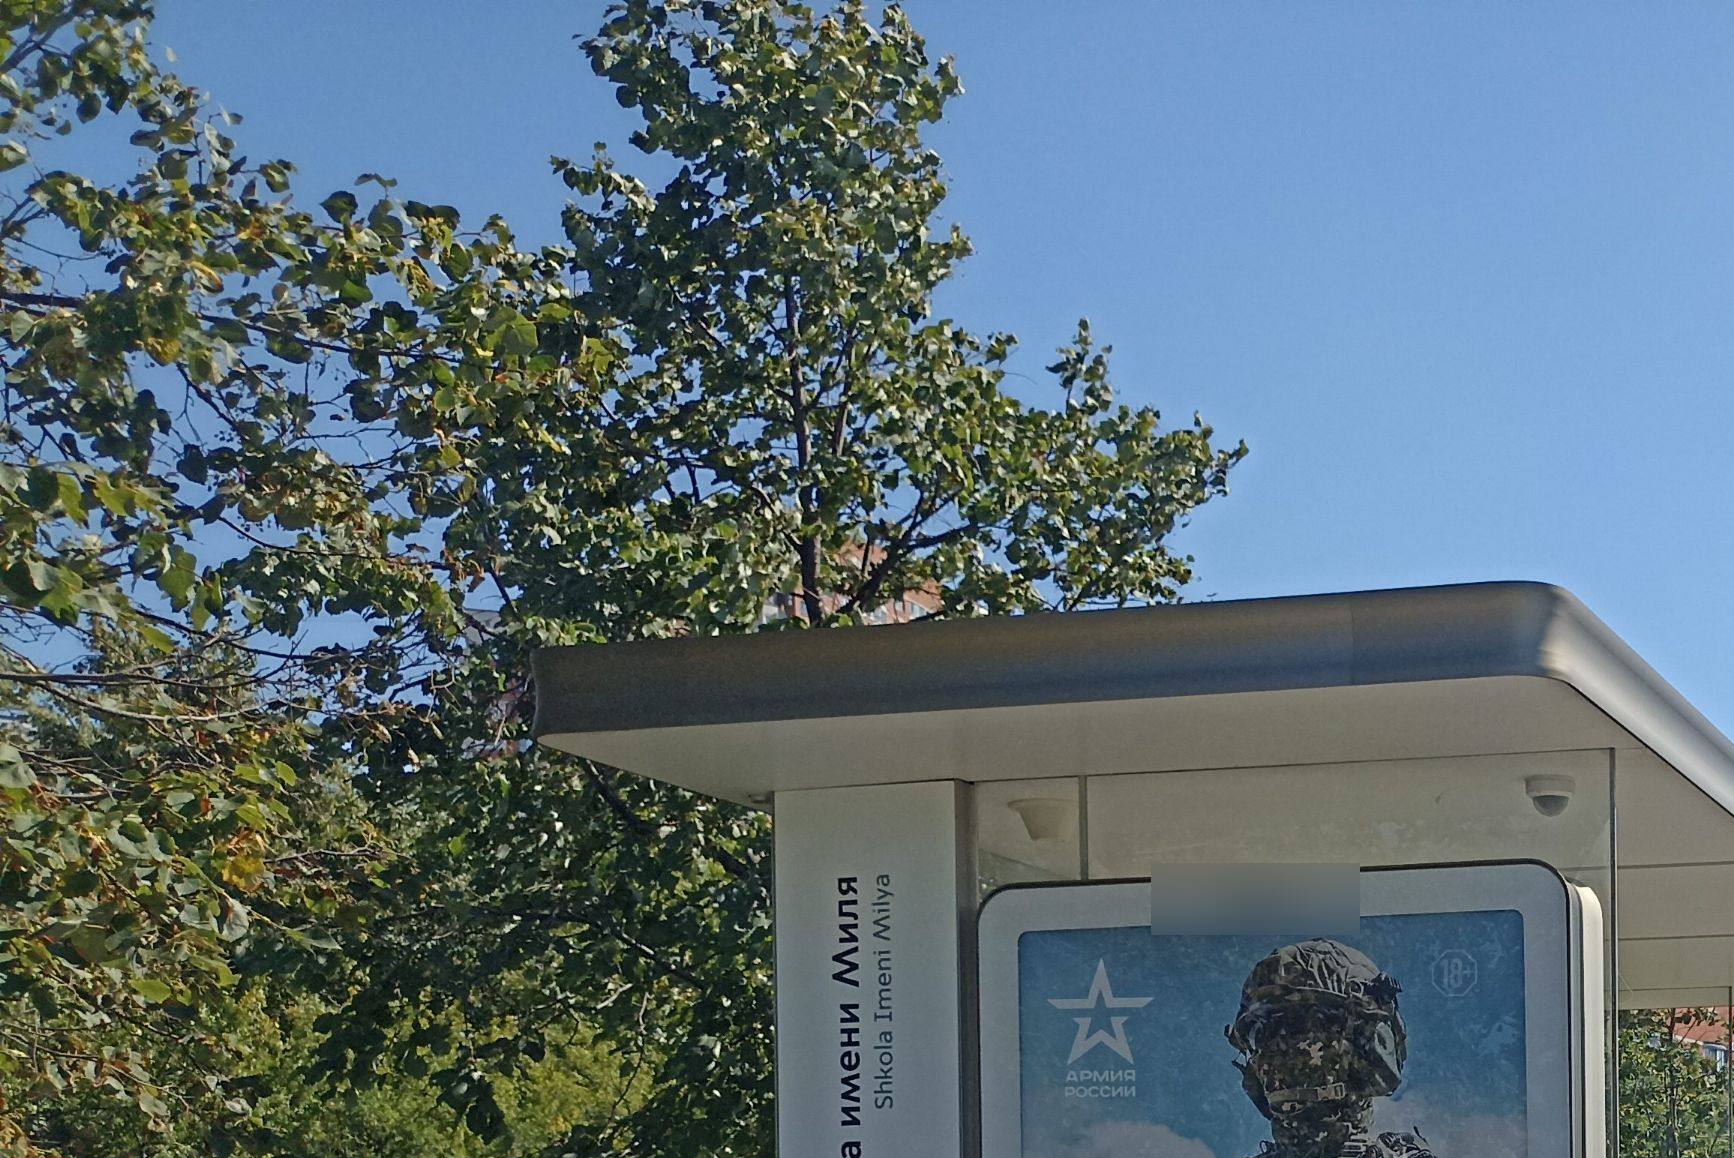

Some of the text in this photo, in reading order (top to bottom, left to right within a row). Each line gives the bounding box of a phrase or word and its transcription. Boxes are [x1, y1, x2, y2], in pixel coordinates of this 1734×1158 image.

[831, 875, 860, 988] Миля
[872, 873, 896, 1110] Shkola Imeni Milya
[1440, 958, 1475, 989] 18+
[839, 1003, 861, 1127] имени
[1064, 1085, 1136, 1098] РОССИИ
[1065, 1069, 1136, 1083] АРМИЯ
